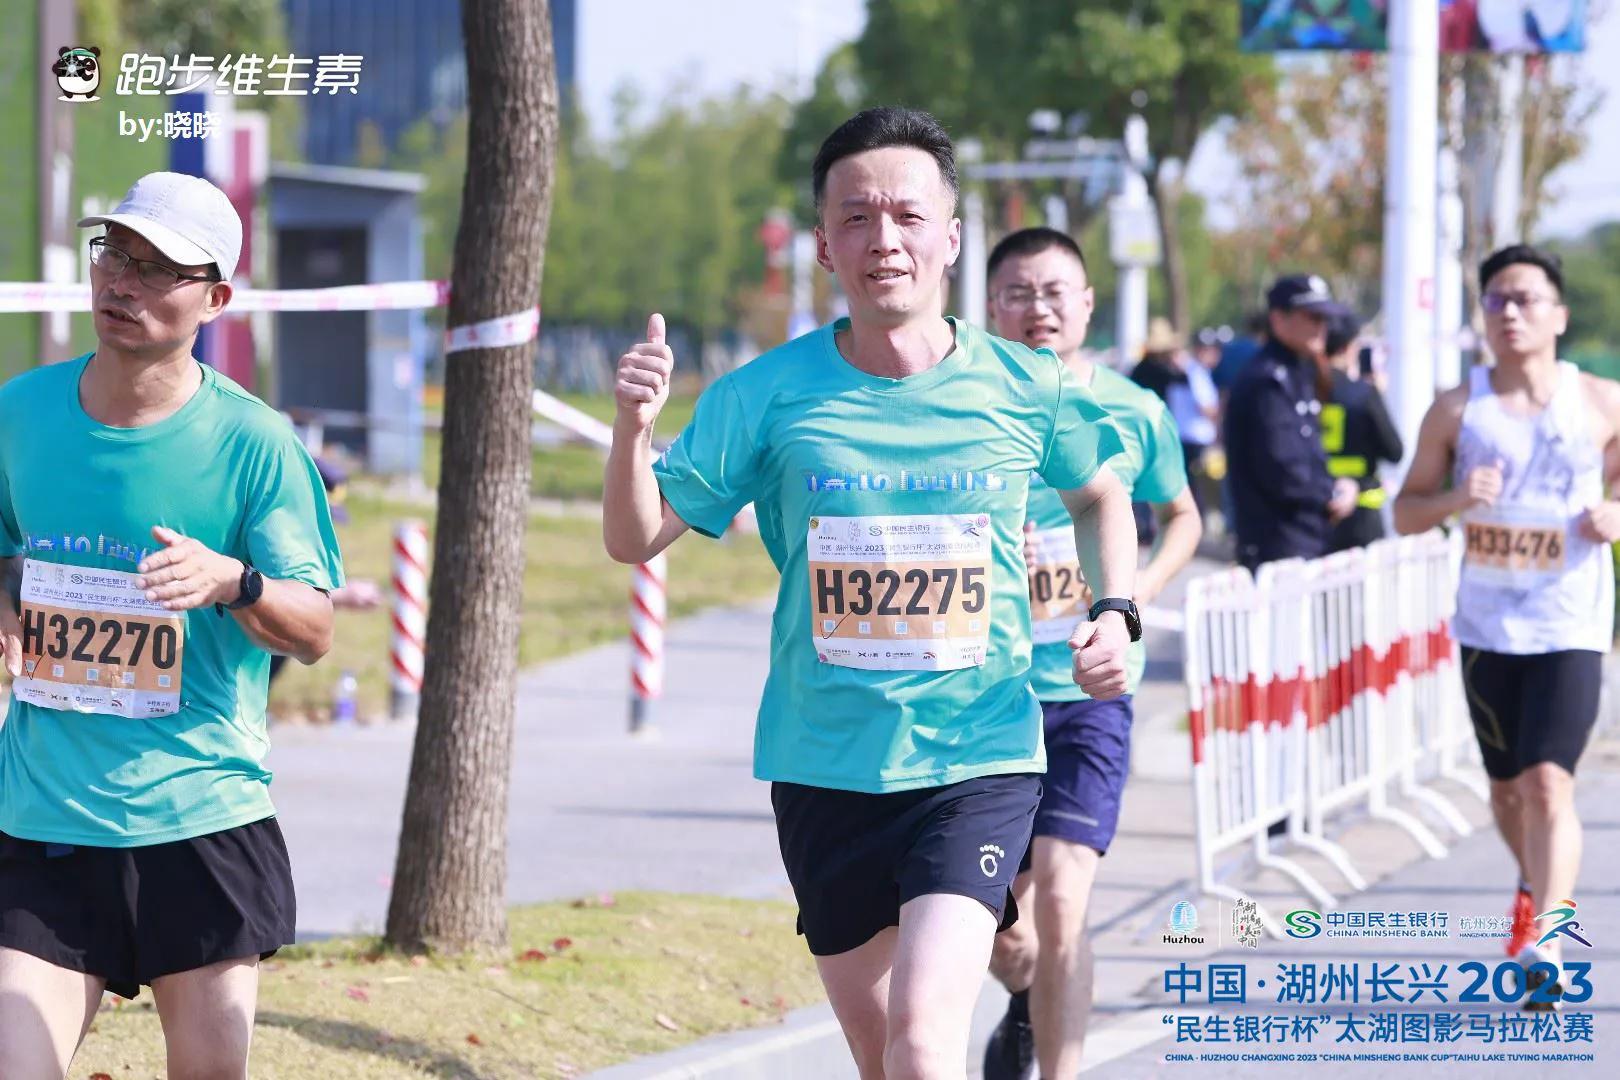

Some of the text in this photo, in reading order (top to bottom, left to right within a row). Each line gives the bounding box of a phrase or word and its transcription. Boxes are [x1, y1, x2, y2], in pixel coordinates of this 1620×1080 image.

[1467, 523, 1561, 559] H33476
[65, 591, 83, 600] 2023
[816, 567, 986, 616] H32275
[24, 609, 177, 670] H32270
